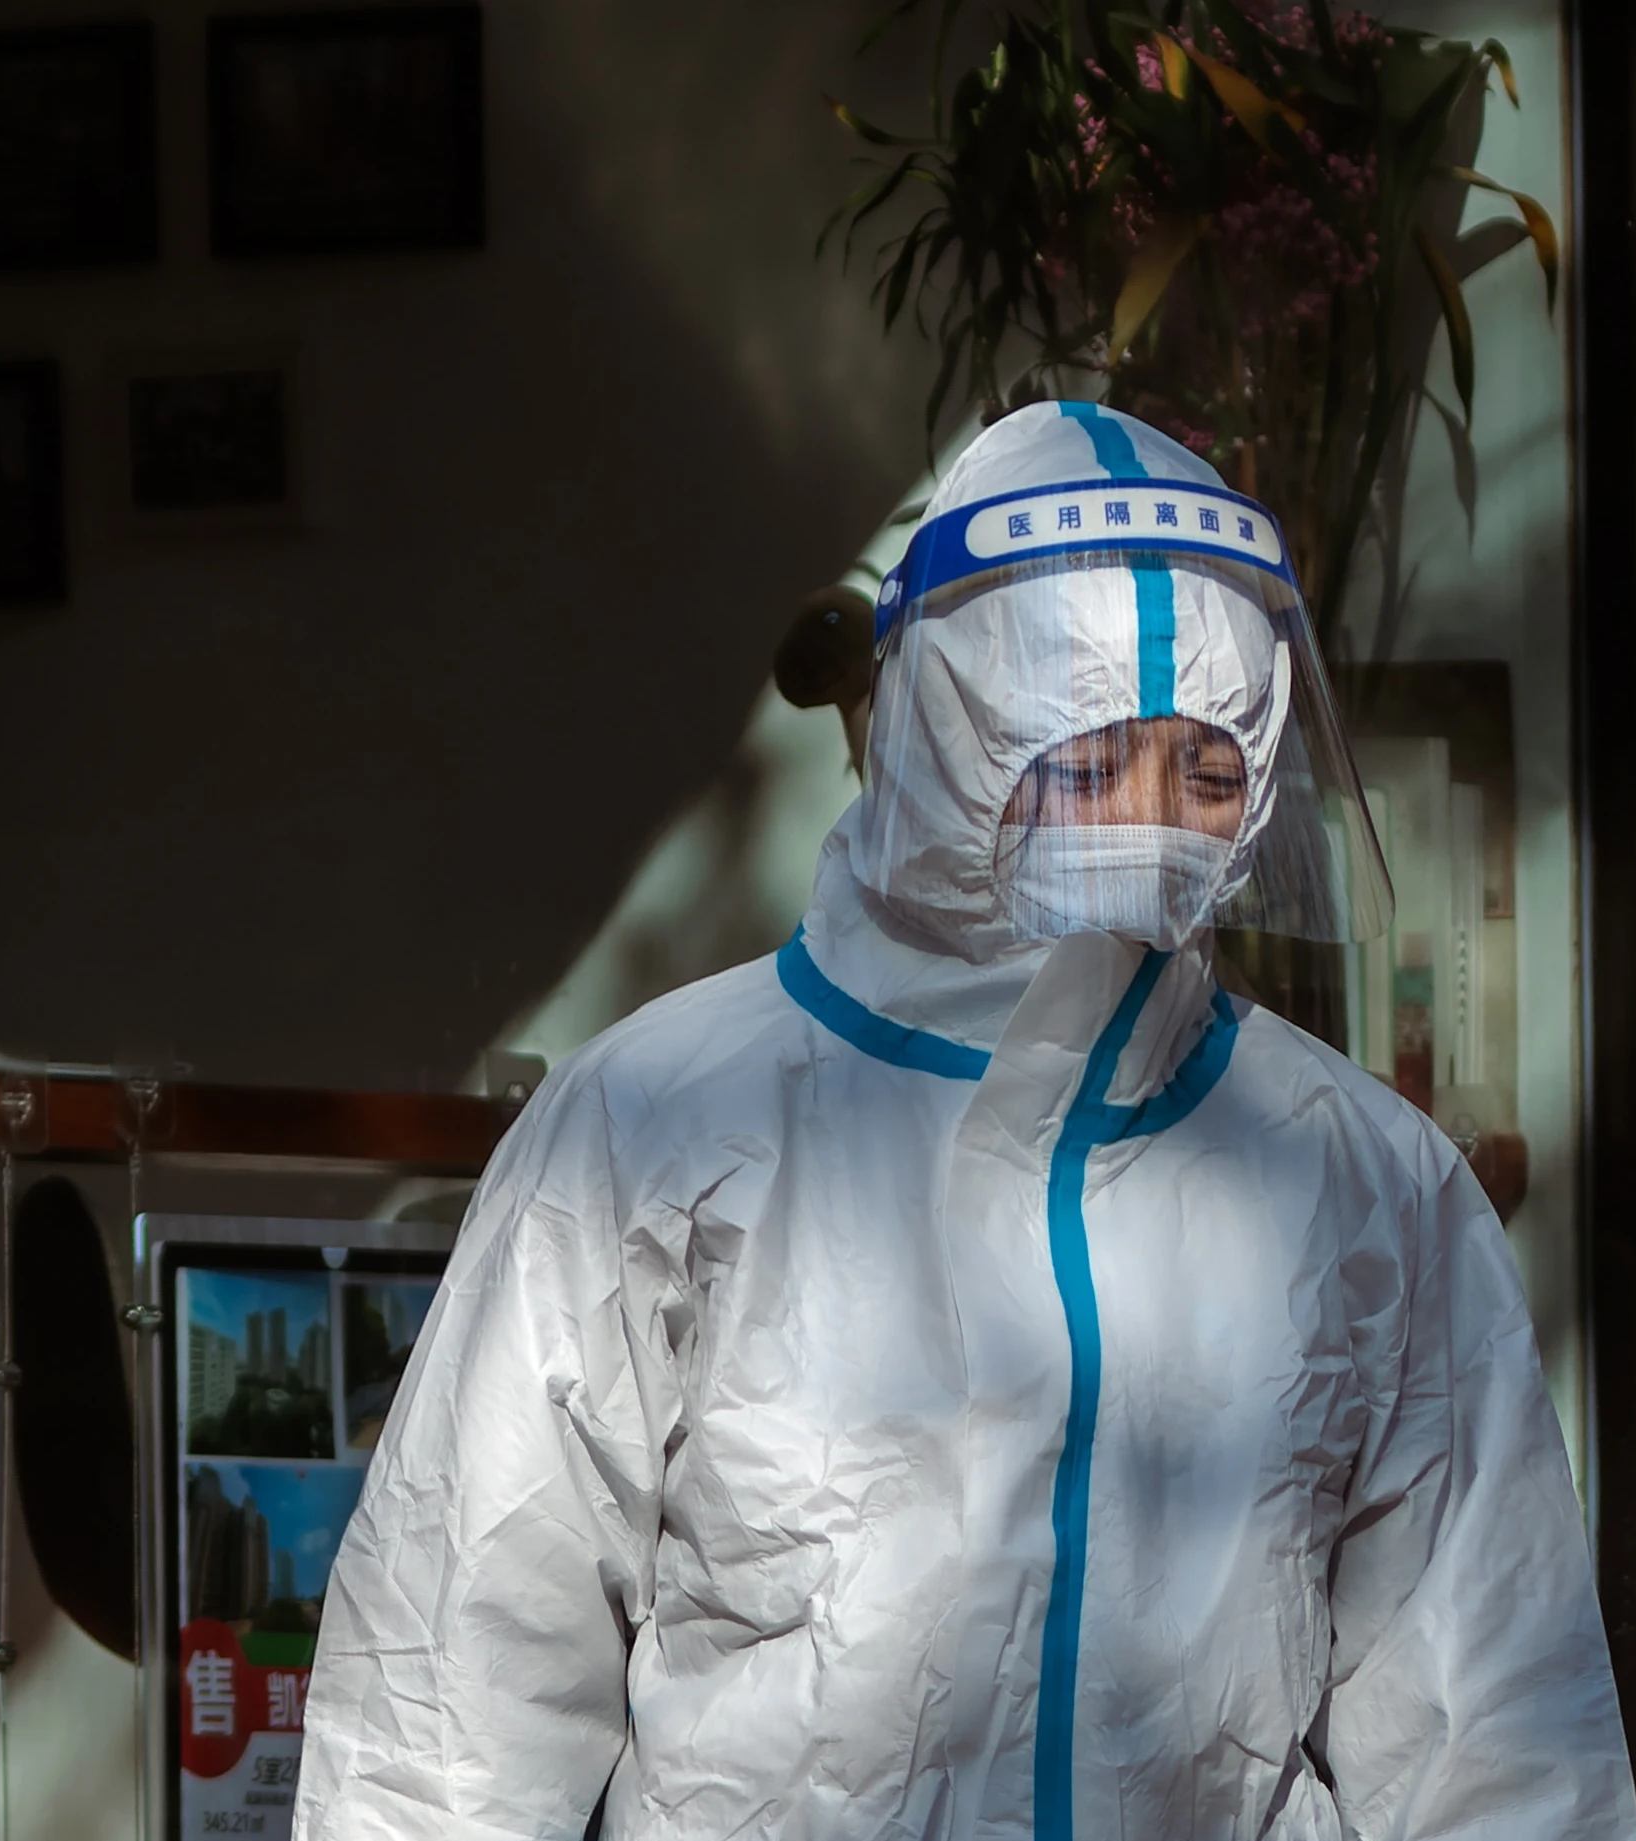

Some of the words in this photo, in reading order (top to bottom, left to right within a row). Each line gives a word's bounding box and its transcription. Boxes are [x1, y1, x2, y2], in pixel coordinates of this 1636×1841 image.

[1008, 499, 1258, 544] 医用隔离面罩
[186, 1648, 237, 1736] 售
[266, 1671, 309, 1729] 凯
